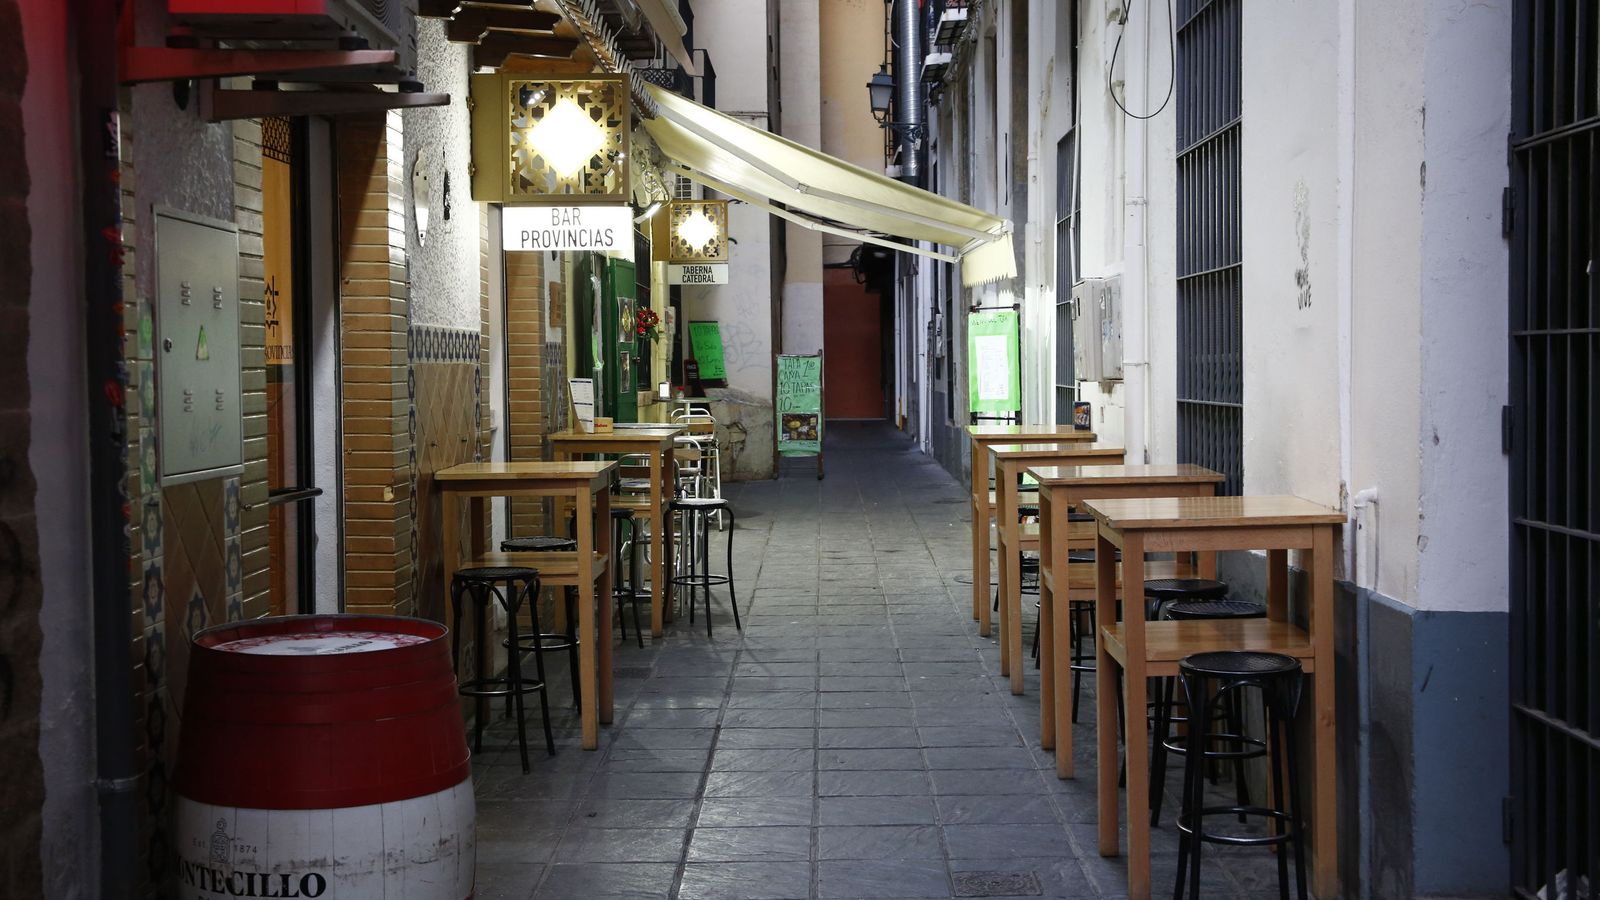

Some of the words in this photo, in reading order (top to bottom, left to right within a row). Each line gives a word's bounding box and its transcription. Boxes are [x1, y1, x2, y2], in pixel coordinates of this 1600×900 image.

[551, 207, 582, 226] BAR
[521, 228, 614, 249] PROVINCIAS
[682, 265, 713, 275] TABERNA
[682, 274, 716, 284] CATEDRAL
